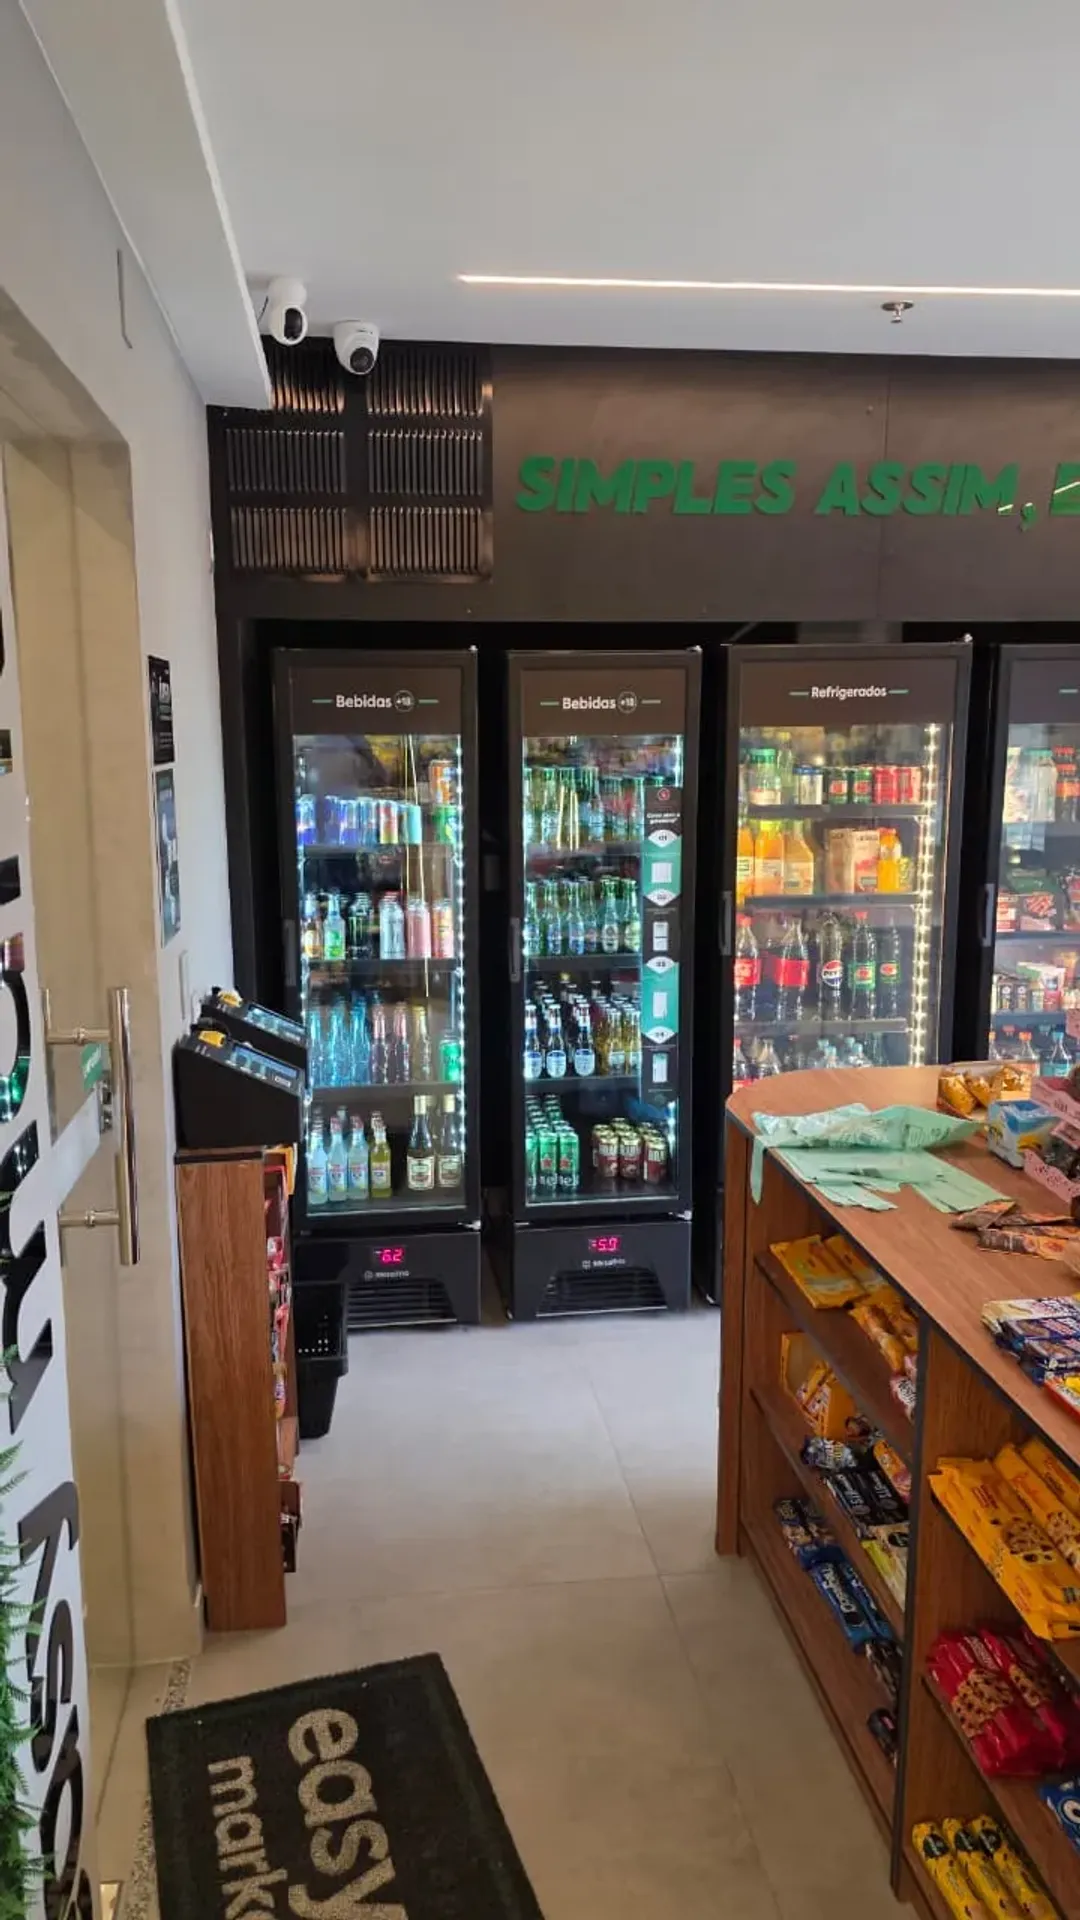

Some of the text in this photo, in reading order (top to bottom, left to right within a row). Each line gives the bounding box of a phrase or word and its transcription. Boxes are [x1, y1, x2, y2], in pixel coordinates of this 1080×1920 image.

[515, 455, 797, 515] SIMPLES
[813, 461, 1038, 532] ASSIM,
[336, 693, 393, 709] Bebidas
[811, 685, 887, 701] Refrigerados
[562, 695, 617, 710] Bebidas
[286, 1707, 409, 1920] easy
